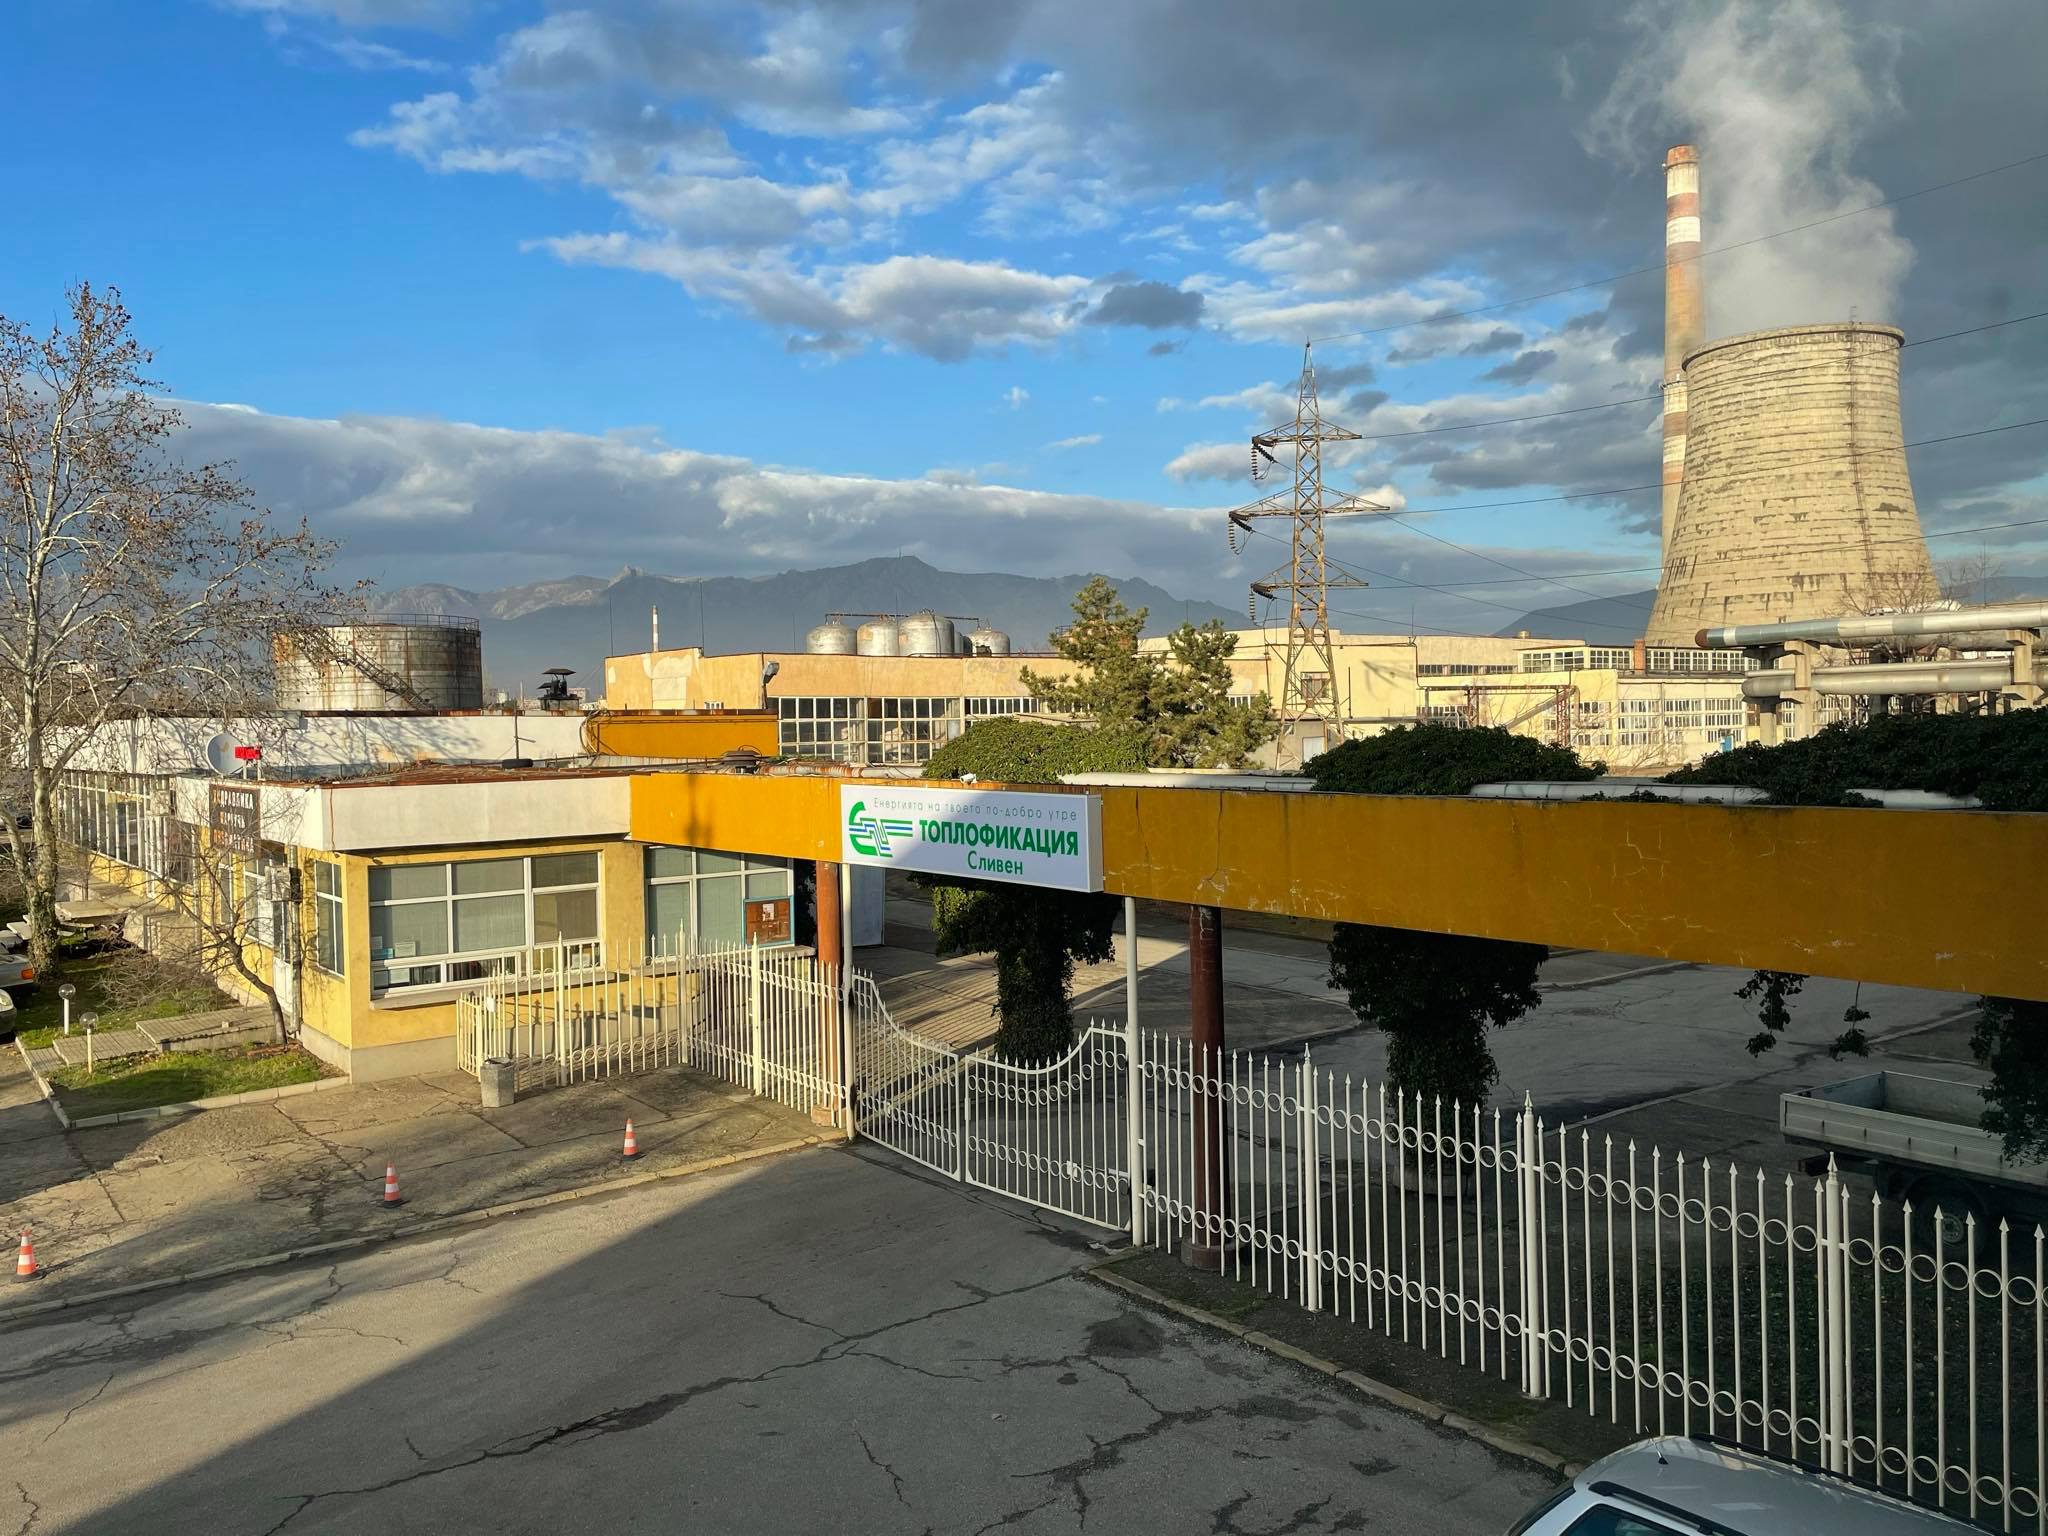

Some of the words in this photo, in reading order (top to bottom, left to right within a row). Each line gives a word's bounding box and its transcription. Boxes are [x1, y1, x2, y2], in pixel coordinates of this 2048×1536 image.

[874, 798, 924, 811] Енергията
[928, 804, 941, 812] на
[946, 804, 981, 814] твоето
[986, 805, 1042, 819] по-добро
[1048, 810, 1077, 821] утре
[919, 819, 1079, 858] ТОПЛОФИКАЦИЯ
[967, 850, 1024, 875] Сливен
